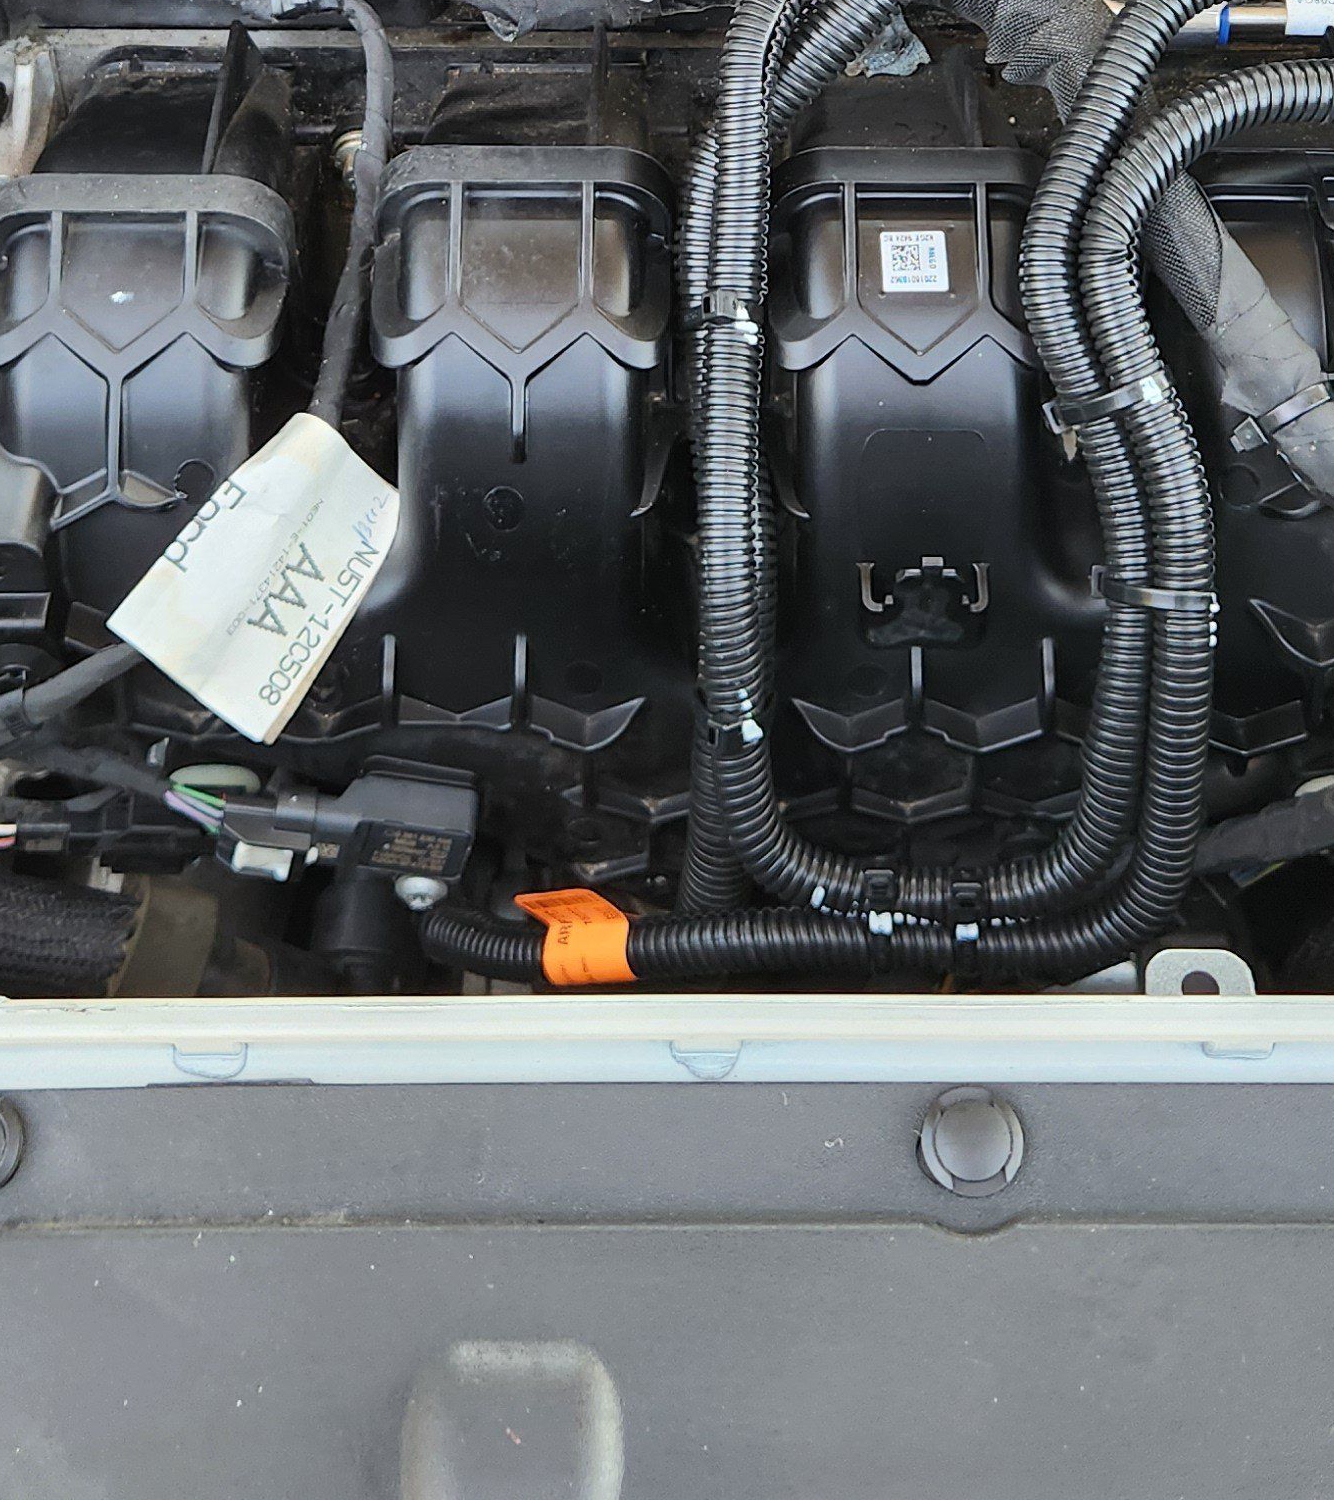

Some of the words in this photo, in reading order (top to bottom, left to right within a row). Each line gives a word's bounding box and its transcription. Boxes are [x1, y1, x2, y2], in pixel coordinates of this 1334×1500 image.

[163, 479, 248, 574] Ford
[247, 541, 326, 637] AAA
[259, 538, 380, 706] NU5T-12C508
